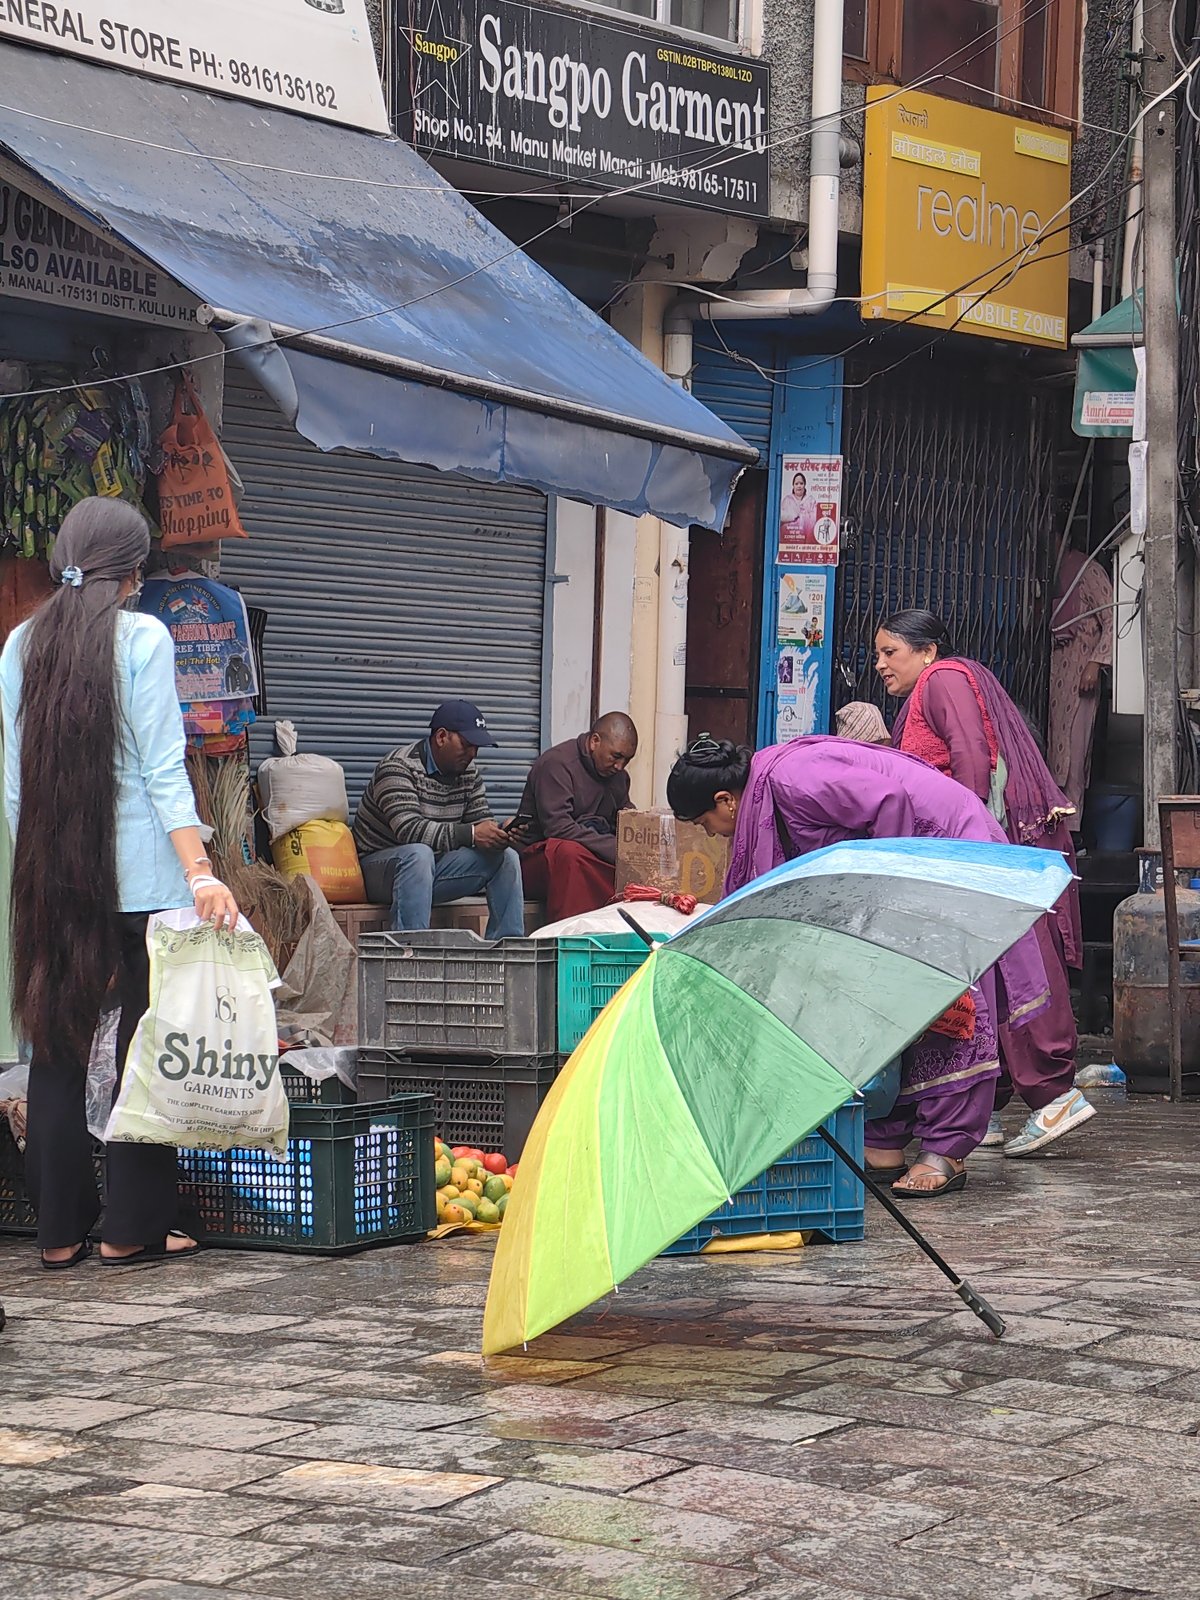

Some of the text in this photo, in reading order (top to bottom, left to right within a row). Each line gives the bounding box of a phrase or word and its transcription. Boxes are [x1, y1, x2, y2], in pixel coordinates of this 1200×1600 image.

[100, 18, 183, 69] STORE
[190, 48, 224, 79] PH:
[230, 59, 338, 110] 9816136182
[414, 33, 457, 62] Sangpo
[479, 13, 766, 155] Sangpo Garment
[414, 110, 449, 139] Shop
[510, 131, 549, 158] Manu
[552, 140, 597, 169] Market
[600, 150, 643, 180] Manali
[917, 182, 1042, 255] realme
[45, 253, 157, 297] AVAILABLE
[8, 273, 54, 295] MANALI
[101, 293, 136, 312] DISTT.
[139, 300, 176, 319] KULLU
[961, 297, 1065, 339] MOBILE ZONE
[1084, 404, 1107, 417] Amrit
[174, 491, 204, 508] TIME
[207, 486, 224, 500] TO
[161, 505, 232, 536] Shopping
[175, 644, 221, 653] REE TIBET
[176, 658, 188, 666] eel
[158, 1032, 279, 1091] Shiny
[167, 1098, 179, 1106] THE
[181, 1102, 213, 1112] COMPLETE
[215, 1108, 248, 1117] GARMENTS
[184, 1081, 255, 1099] GARMENTS
